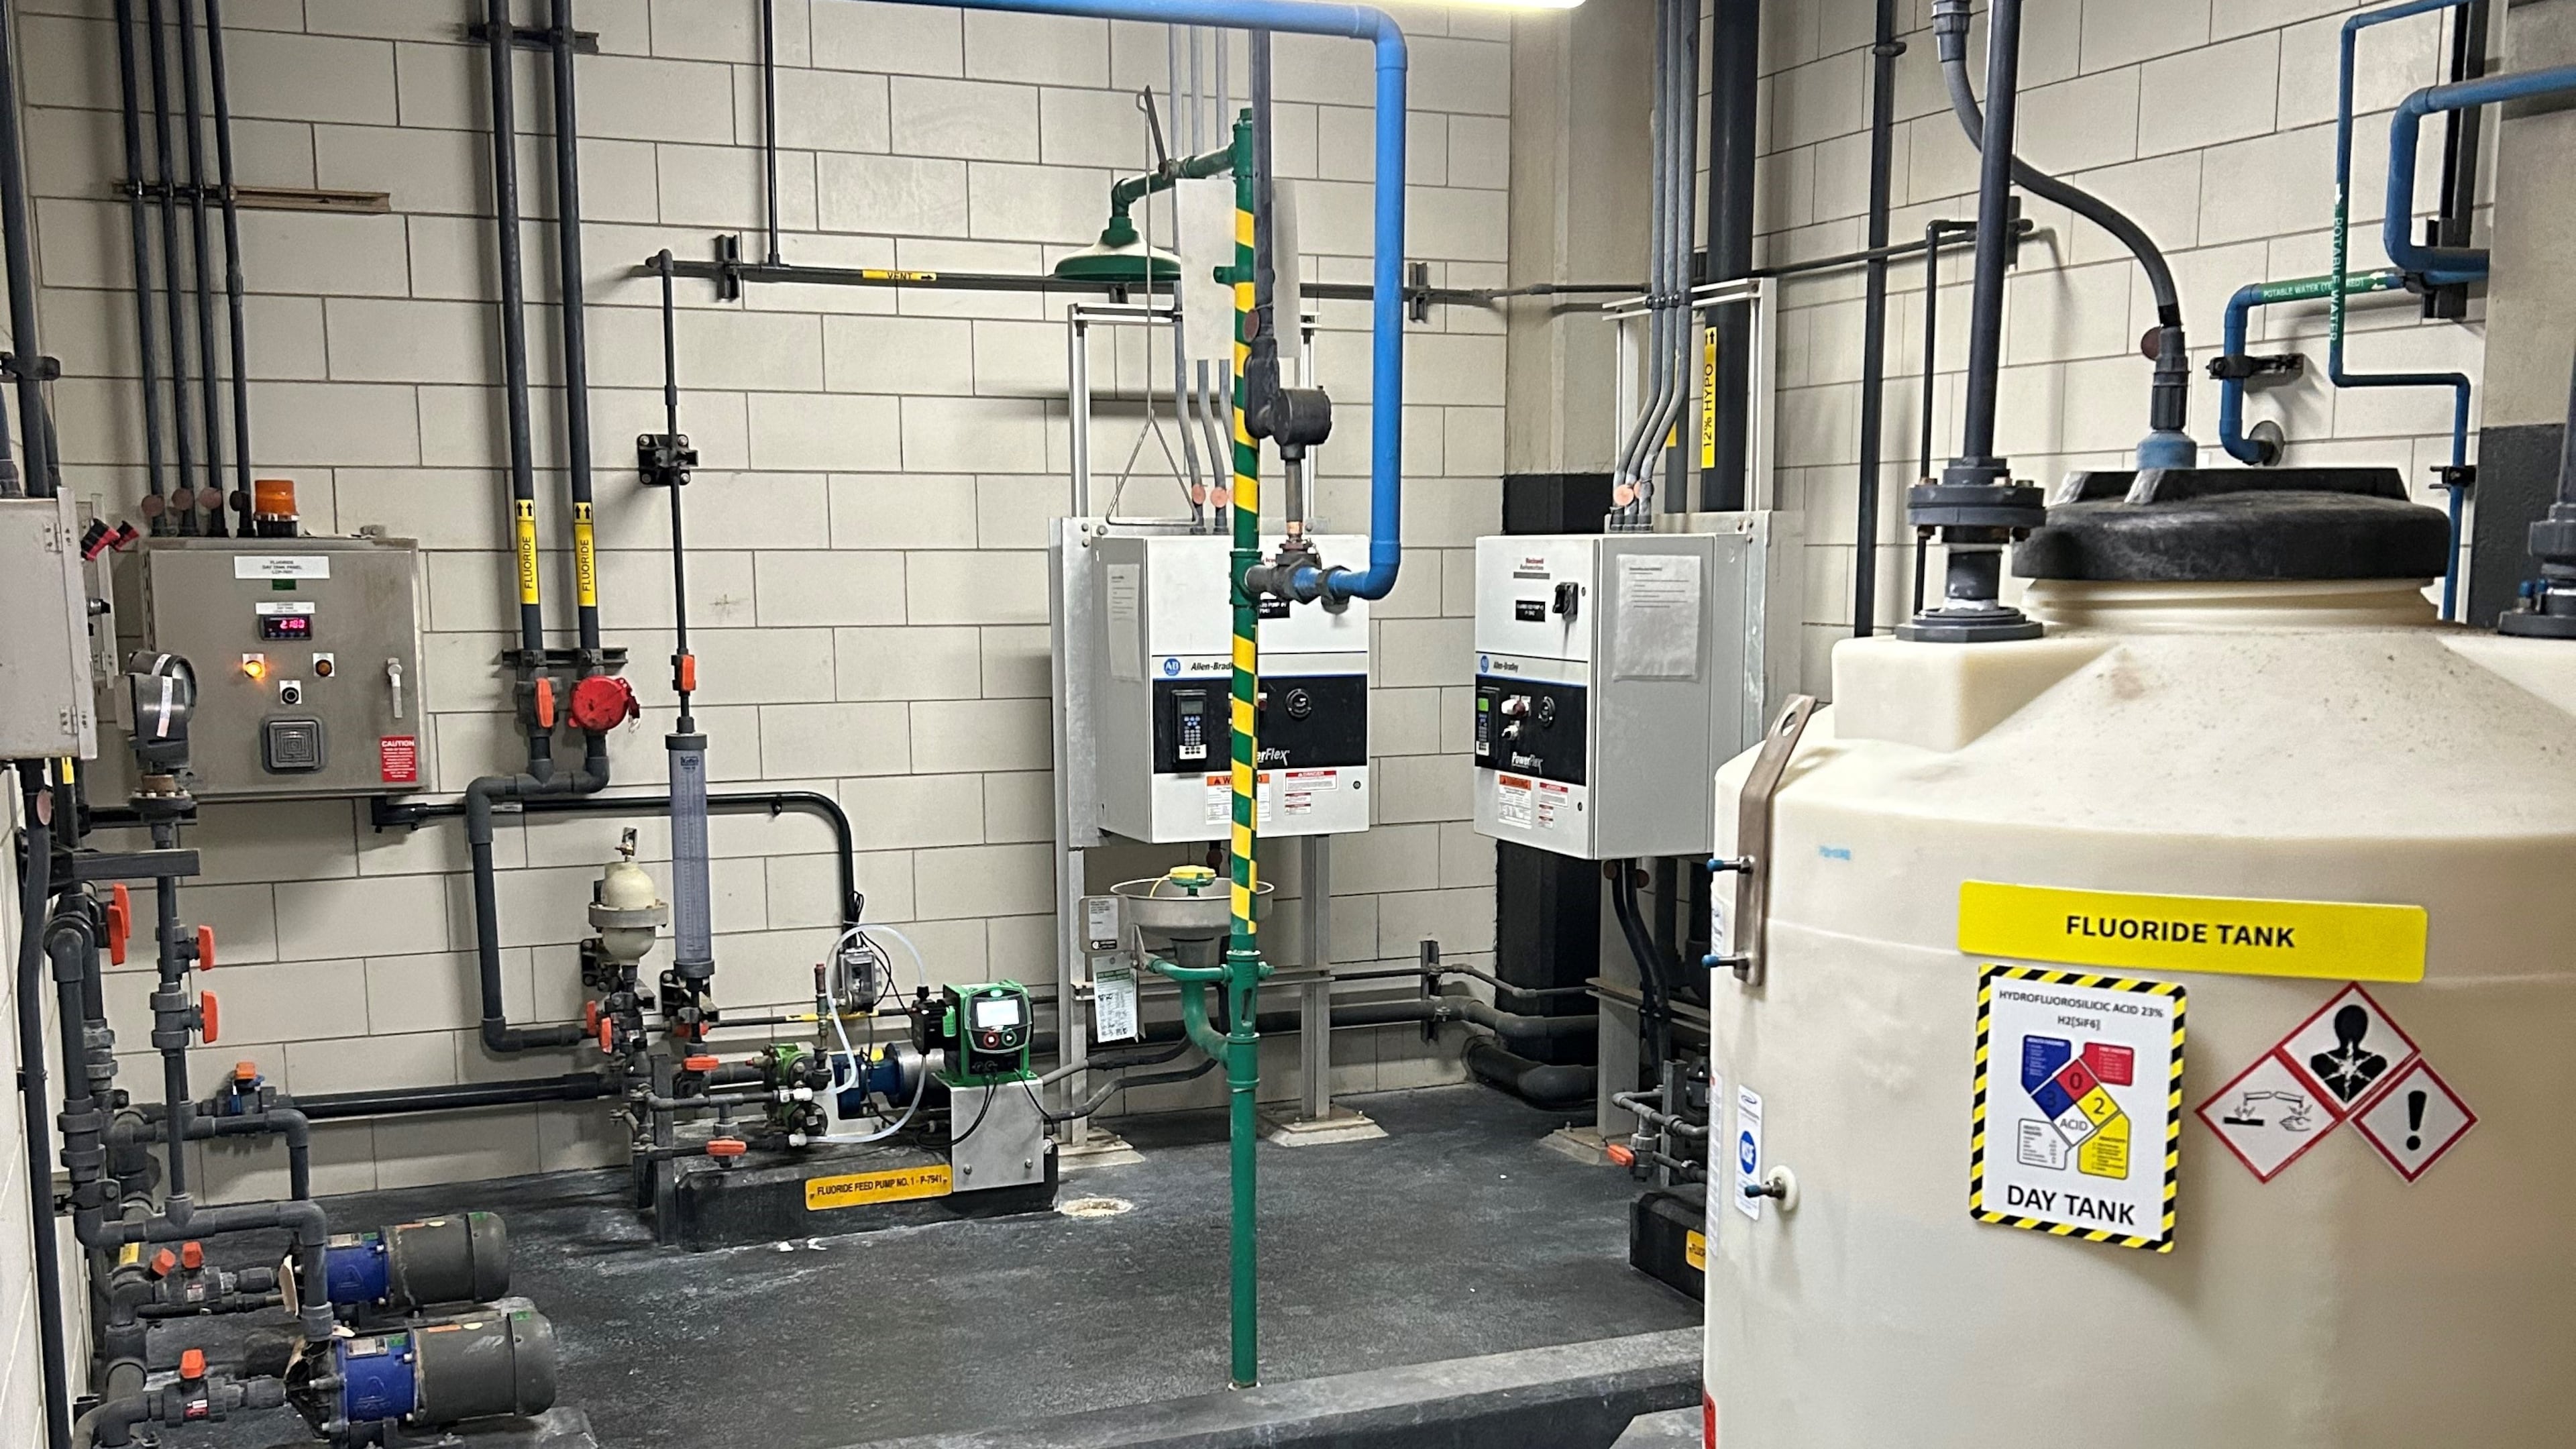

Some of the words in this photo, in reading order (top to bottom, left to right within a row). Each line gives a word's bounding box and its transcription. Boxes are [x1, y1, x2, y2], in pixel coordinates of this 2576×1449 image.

[2332, 217, 2343, 283] POTABLE
[887, 272, 913, 280] VENT
[2263, 286, 2293, 297] POTABLE
[2294, 282, 2319, 294] WATER
[2330, 290, 2339, 341] WATER
[1705, 364, 1713, 411] HYPO
[1703, 417, 1713, 447] 12%
[522, 537, 533, 589] FLUORIDE
[580, 539, 591, 592] FLUORIDE
[2065, 915, 2208, 943] FLUORIDE
[2216, 924, 2296, 949] TANK
[1998, 989, 2111, 1012] HYDROFLUOROSILICIC
[2112, 1004, 2140, 1015] ACID
[2141, 1006, 2164, 1018] 23%
[2070, 1072, 2084, 1090] 0
[2046, 1091, 2057, 1108] 3
[2093, 1097, 2106, 1115] 2
[2059, 1118, 2088, 1131] ACID
[817, 1183, 853, 1196] FLUORIDE
[855, 1181, 874, 1192] FEED
[875, 1179, 896, 1189] PUMP
[896, 1178, 909, 1187] NO.
[911, 1177, 915, 1185] 1
[2007, 1184, 2057, 1212] DAY
[2063, 1193, 2136, 1226] TANK
